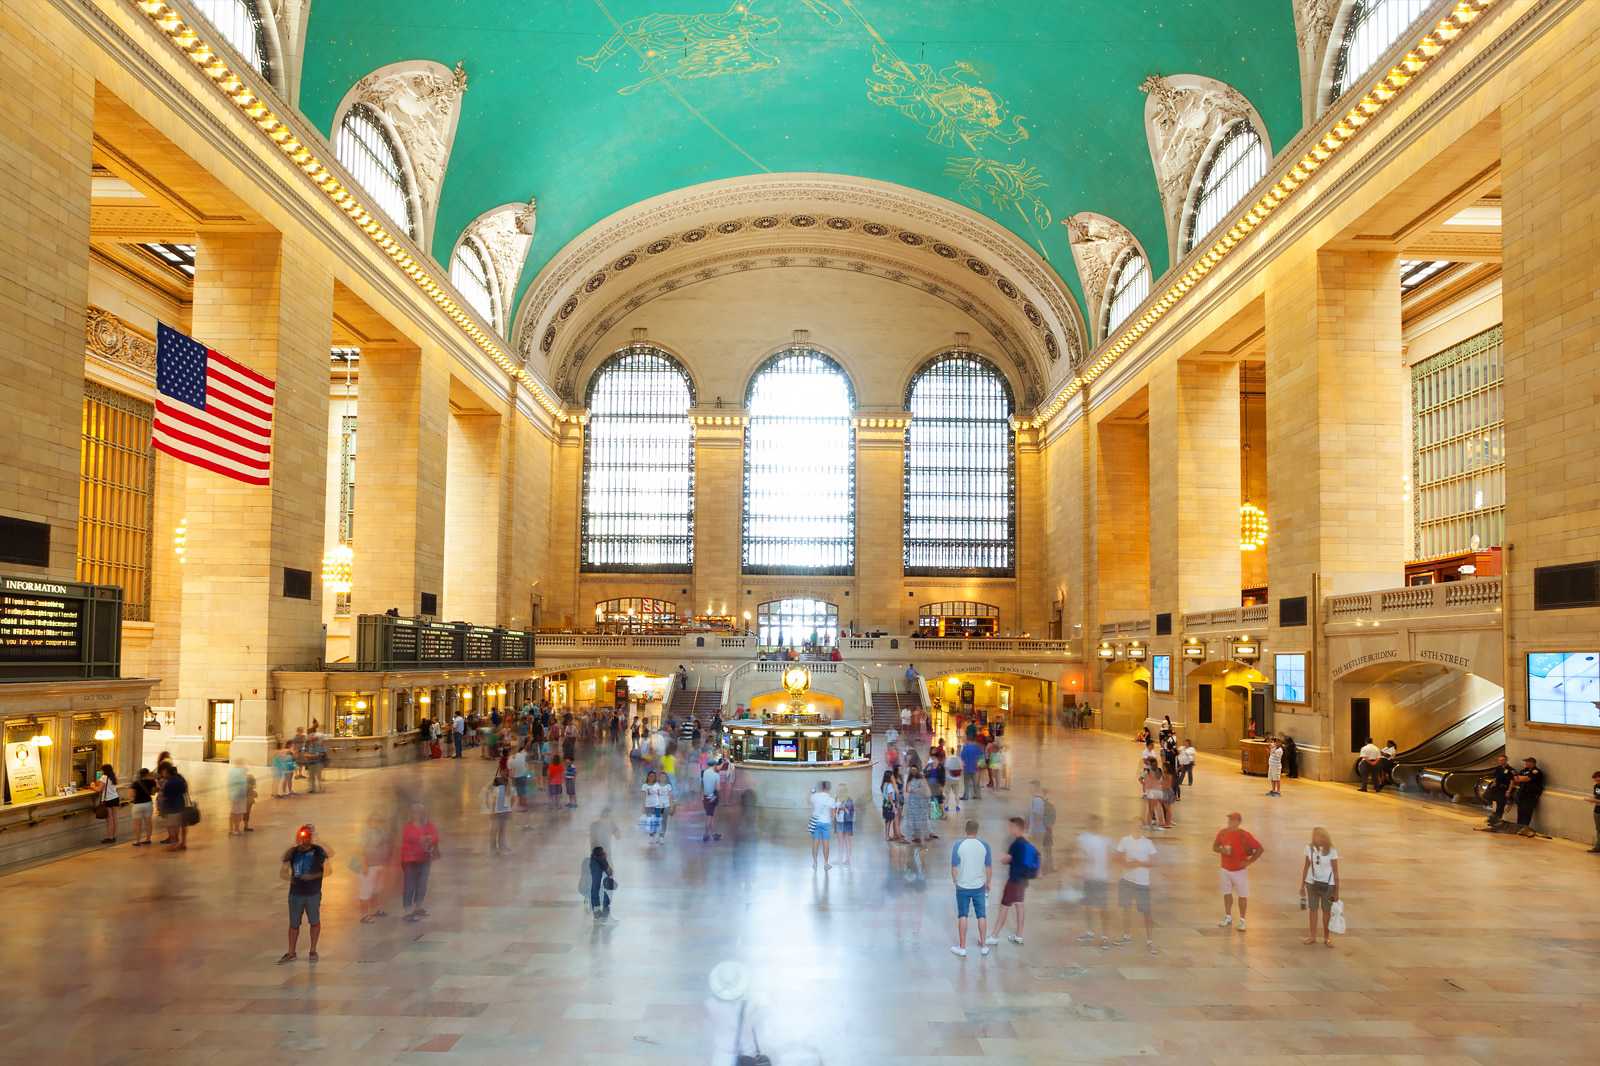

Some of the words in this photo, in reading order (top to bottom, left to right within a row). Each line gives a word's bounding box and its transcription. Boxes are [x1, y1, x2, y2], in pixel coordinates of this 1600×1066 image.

[6, 580, 67, 593] INFORMATION
[1367, 649, 1399, 662] BUILDING
[1439, 652, 1470, 668] STREET
